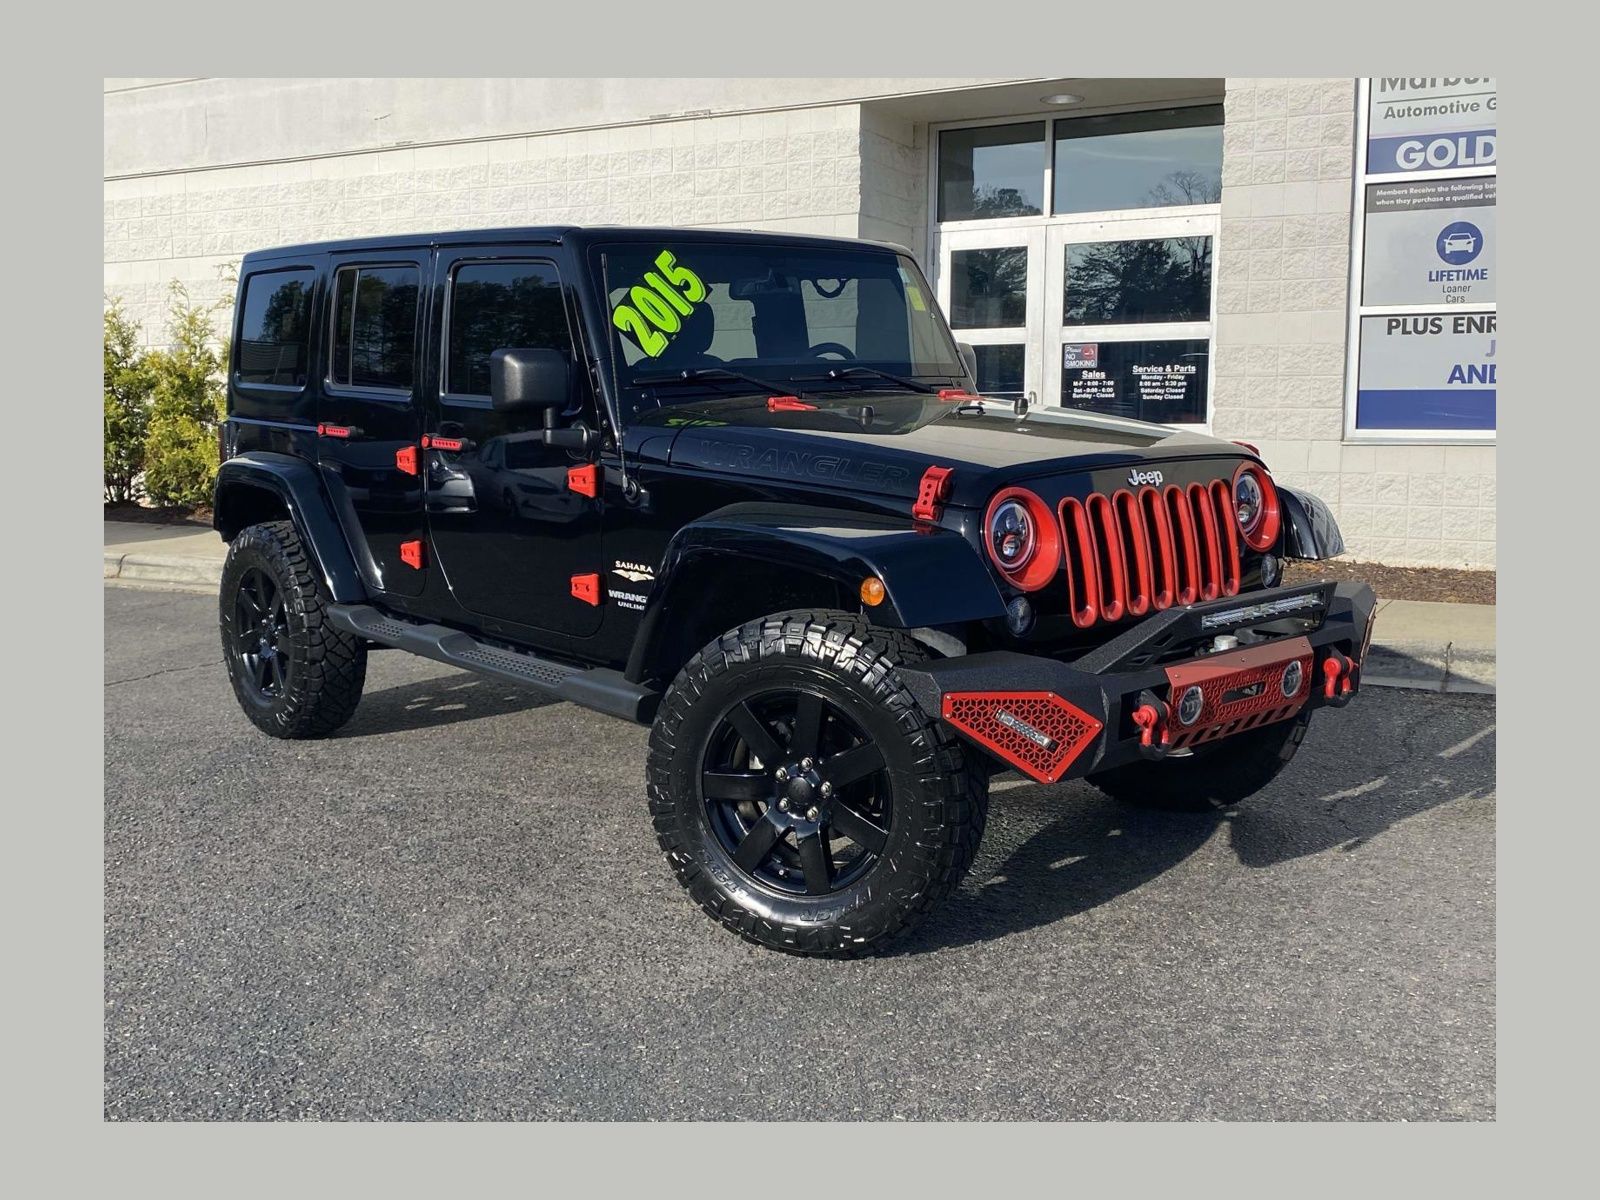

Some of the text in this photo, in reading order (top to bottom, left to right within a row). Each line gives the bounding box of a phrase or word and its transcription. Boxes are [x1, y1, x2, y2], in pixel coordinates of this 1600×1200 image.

[1383, 100, 1481, 120] Automotive
[1395, 135, 1496, 170] GOLD
[1450, 183, 1483, 191] following
[1396, 197, 1411, 206] they
[1412, 196, 1444, 205] purchase
[1452, 193, 1483, 202] qualified
[1428, 269, 1488, 282] LIFETIME
[1442, 285, 1471, 293] Loaner
[612, 249, 707, 358] 2015
[1445, 294, 1466, 304] Cars
[1386, 317, 1443, 335] PLUS
[1065, 359, 1095, 368] SMOKING
[1132, 364, 1197, 373] Service & Parts
[1081, 370, 1106, 379] Sales
[1072, 392, 1093, 400] Sunday
[1140, 387, 1165, 395] Saturday
[1142, 393, 1164, 401] Sunday
[701, 439, 911, 492] WRANGLER
[1127, 468, 1164, 487] Jeep
[615, 560, 654, 574] SAHARA
[608, 589, 648, 603] WRANG
